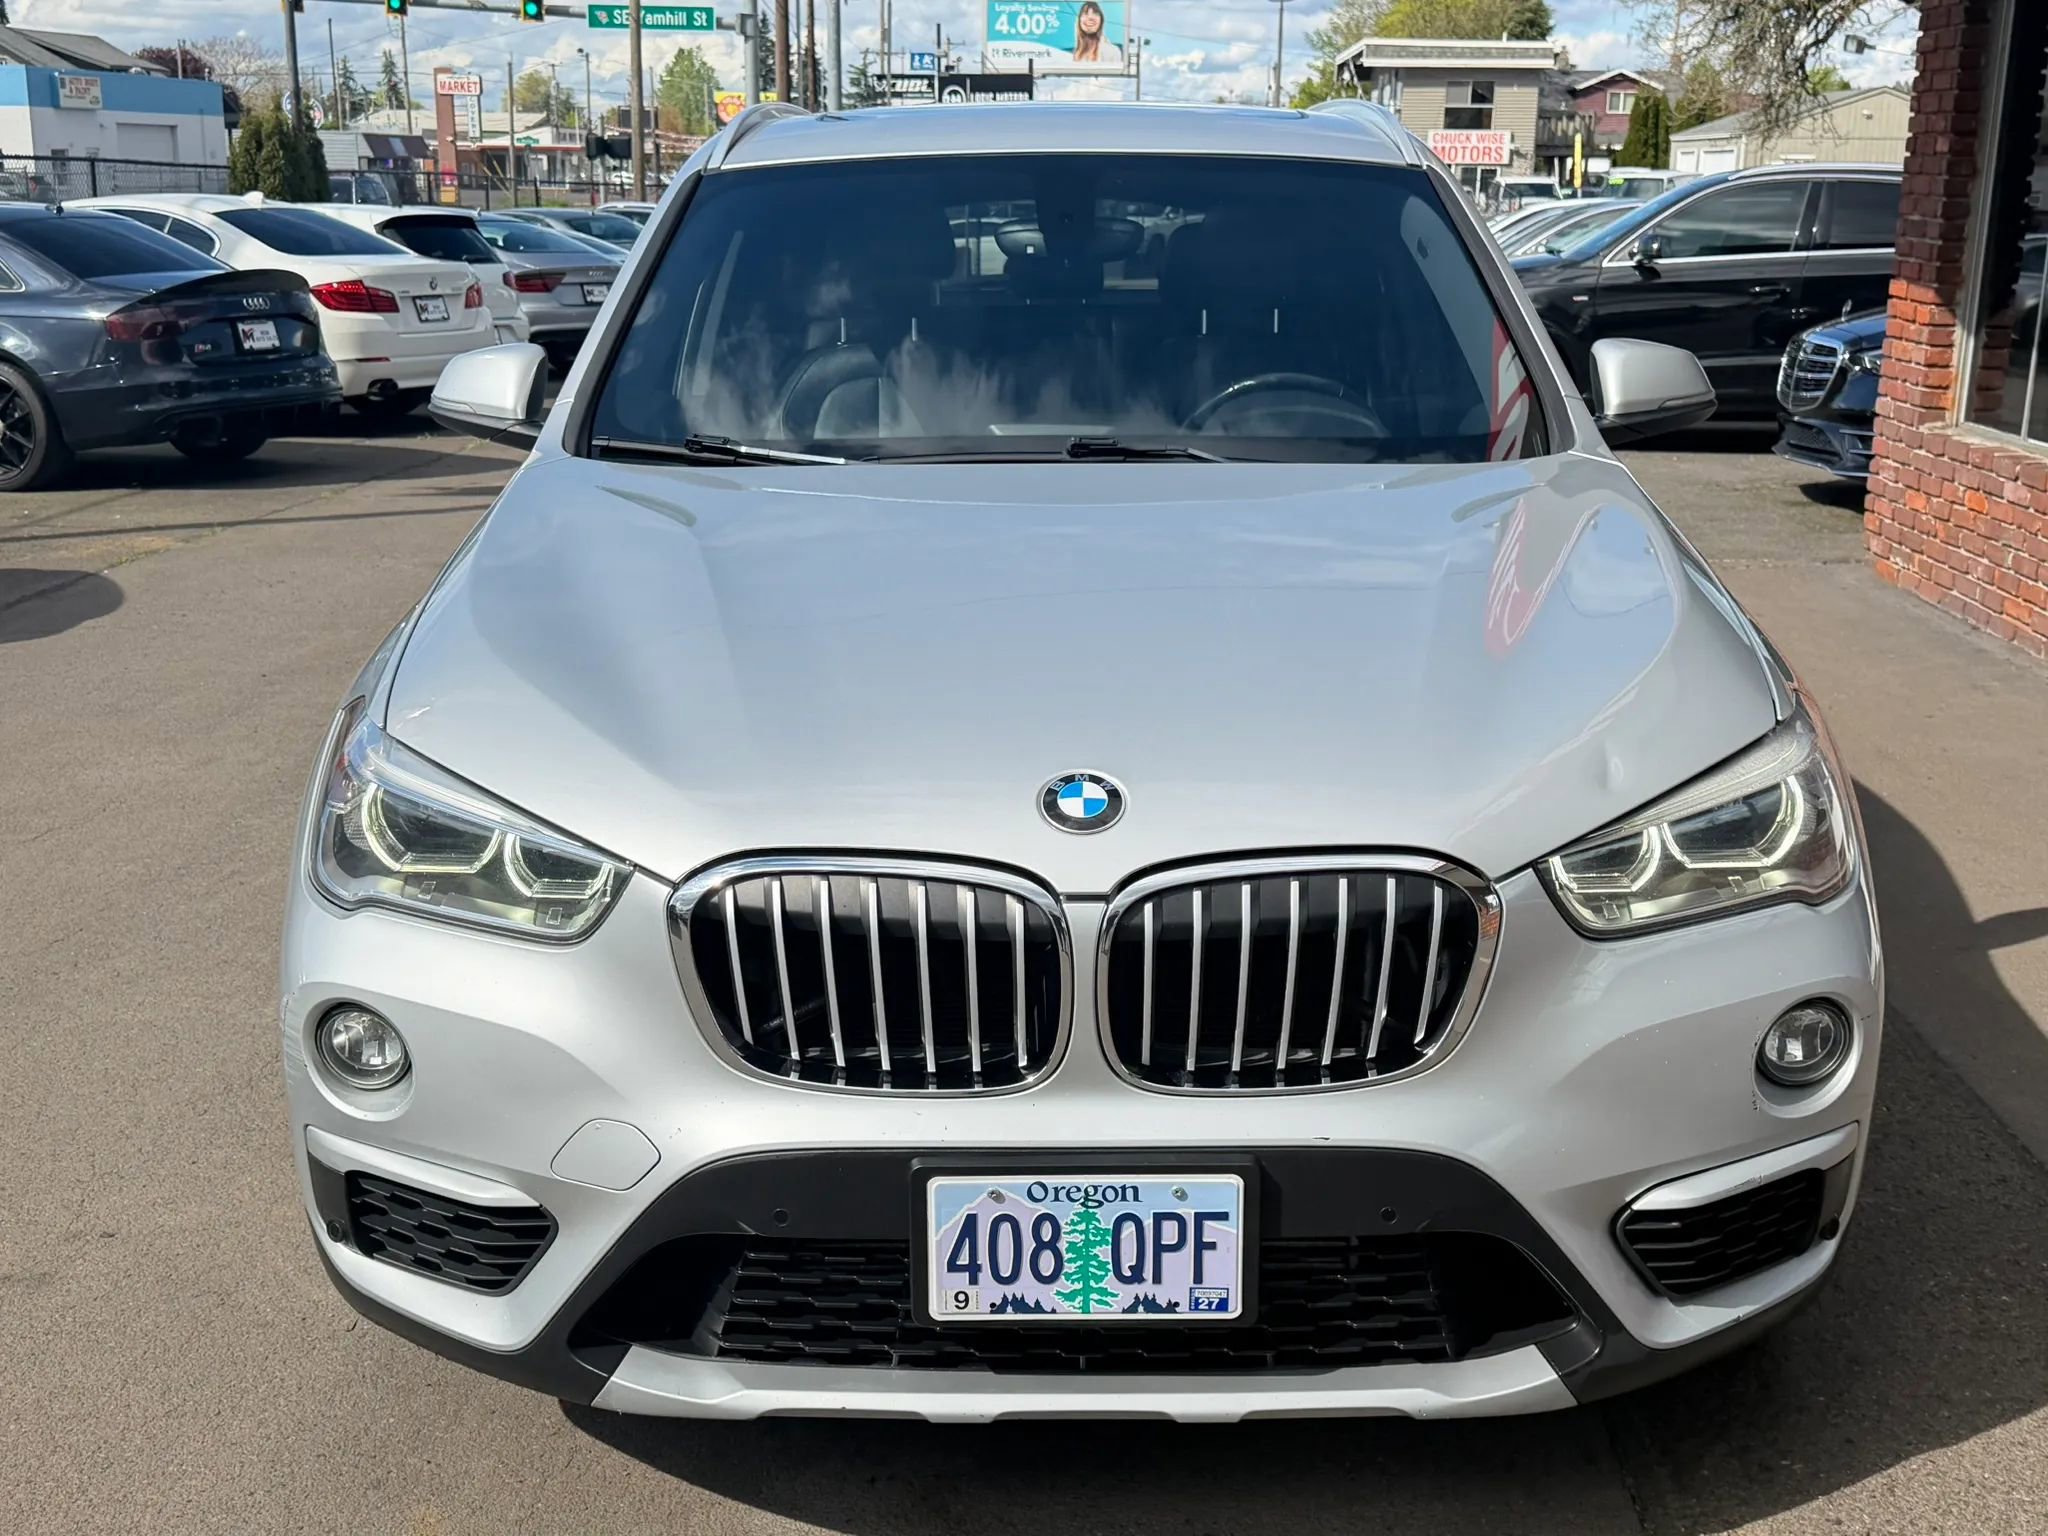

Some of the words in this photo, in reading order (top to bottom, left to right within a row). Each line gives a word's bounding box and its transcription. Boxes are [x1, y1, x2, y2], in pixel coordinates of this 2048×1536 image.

[613, 9, 632, 25] SE
[693, 11, 708, 27] St
[1003, 49, 1053, 60] Rivermark
[439, 80, 479, 93] MARKET
[1432, 132, 1472, 145] CHUCK
[1475, 132, 1506, 145] WISE
[1433, 145, 1504, 163] MOTORS
[1049, 774, 1116, 792] BMW
[1026, 1180, 1143, 1210] Oregon
[946, 1212, 1064, 1287] 408
[1111, 1211, 1230, 1287] QPF
[953, 1290, 970, 1311] 9
[1198, 1297, 1220, 1310] 27
